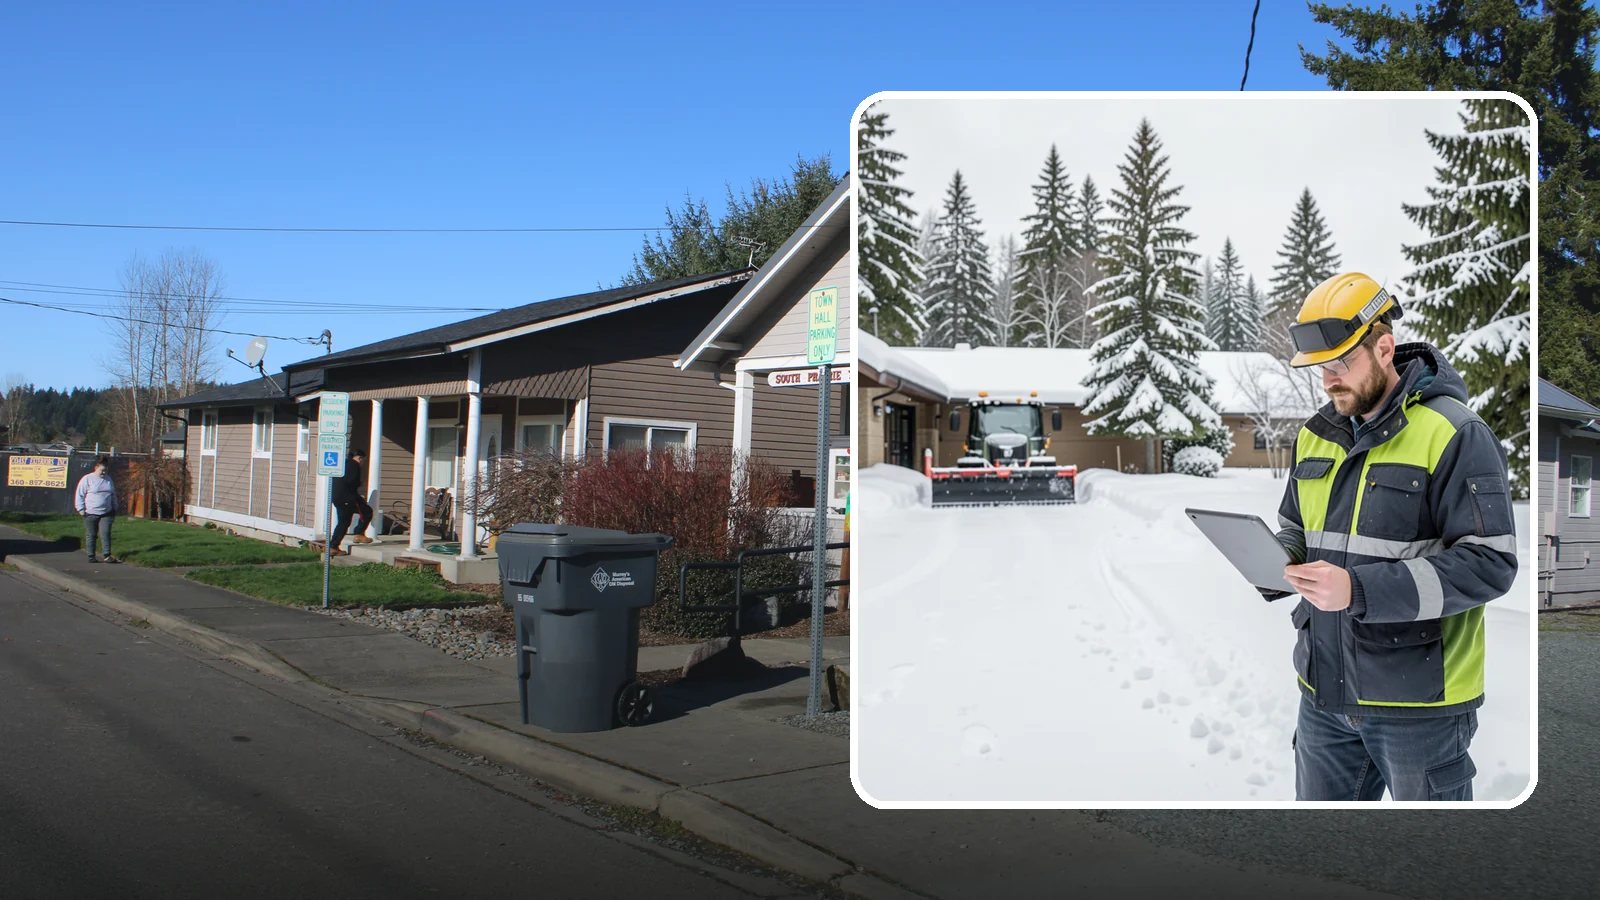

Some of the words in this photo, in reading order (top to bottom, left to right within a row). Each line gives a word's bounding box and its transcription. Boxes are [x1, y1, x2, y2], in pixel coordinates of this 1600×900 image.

[815, 294, 833, 308] TOWN
[814, 311, 831, 324] HALL
[810, 326, 836, 340] PARKING
[813, 344, 831, 357] ONLY
[775, 374, 801, 384] SOUTH
[807, 370, 842, 382] PRIE
[10, 479, 65, 487] 360-897-8625
